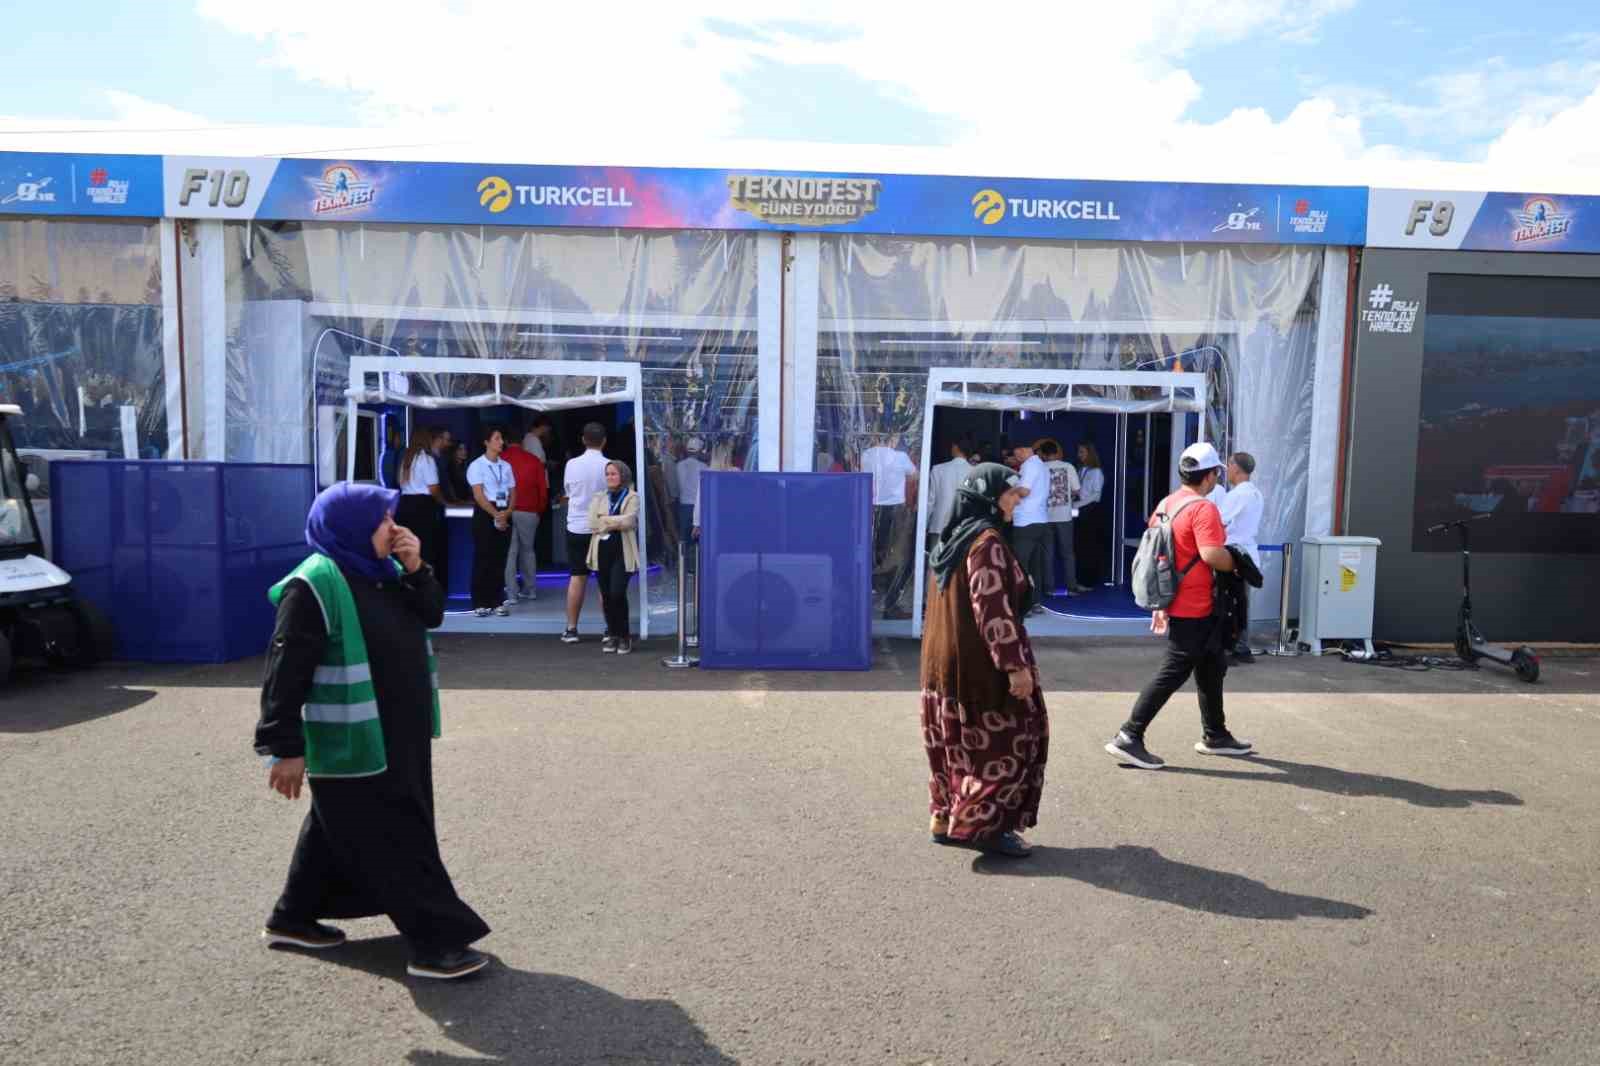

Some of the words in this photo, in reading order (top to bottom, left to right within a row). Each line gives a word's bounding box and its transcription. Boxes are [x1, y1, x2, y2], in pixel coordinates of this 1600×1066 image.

[179, 168, 250, 208] F10
[515, 184, 633, 207] TURKCELL
[727, 175, 879, 202] TEKNOFEST
[1007, 198, 1121, 221] TURKCELL
[1404, 200, 1456, 237] F9
